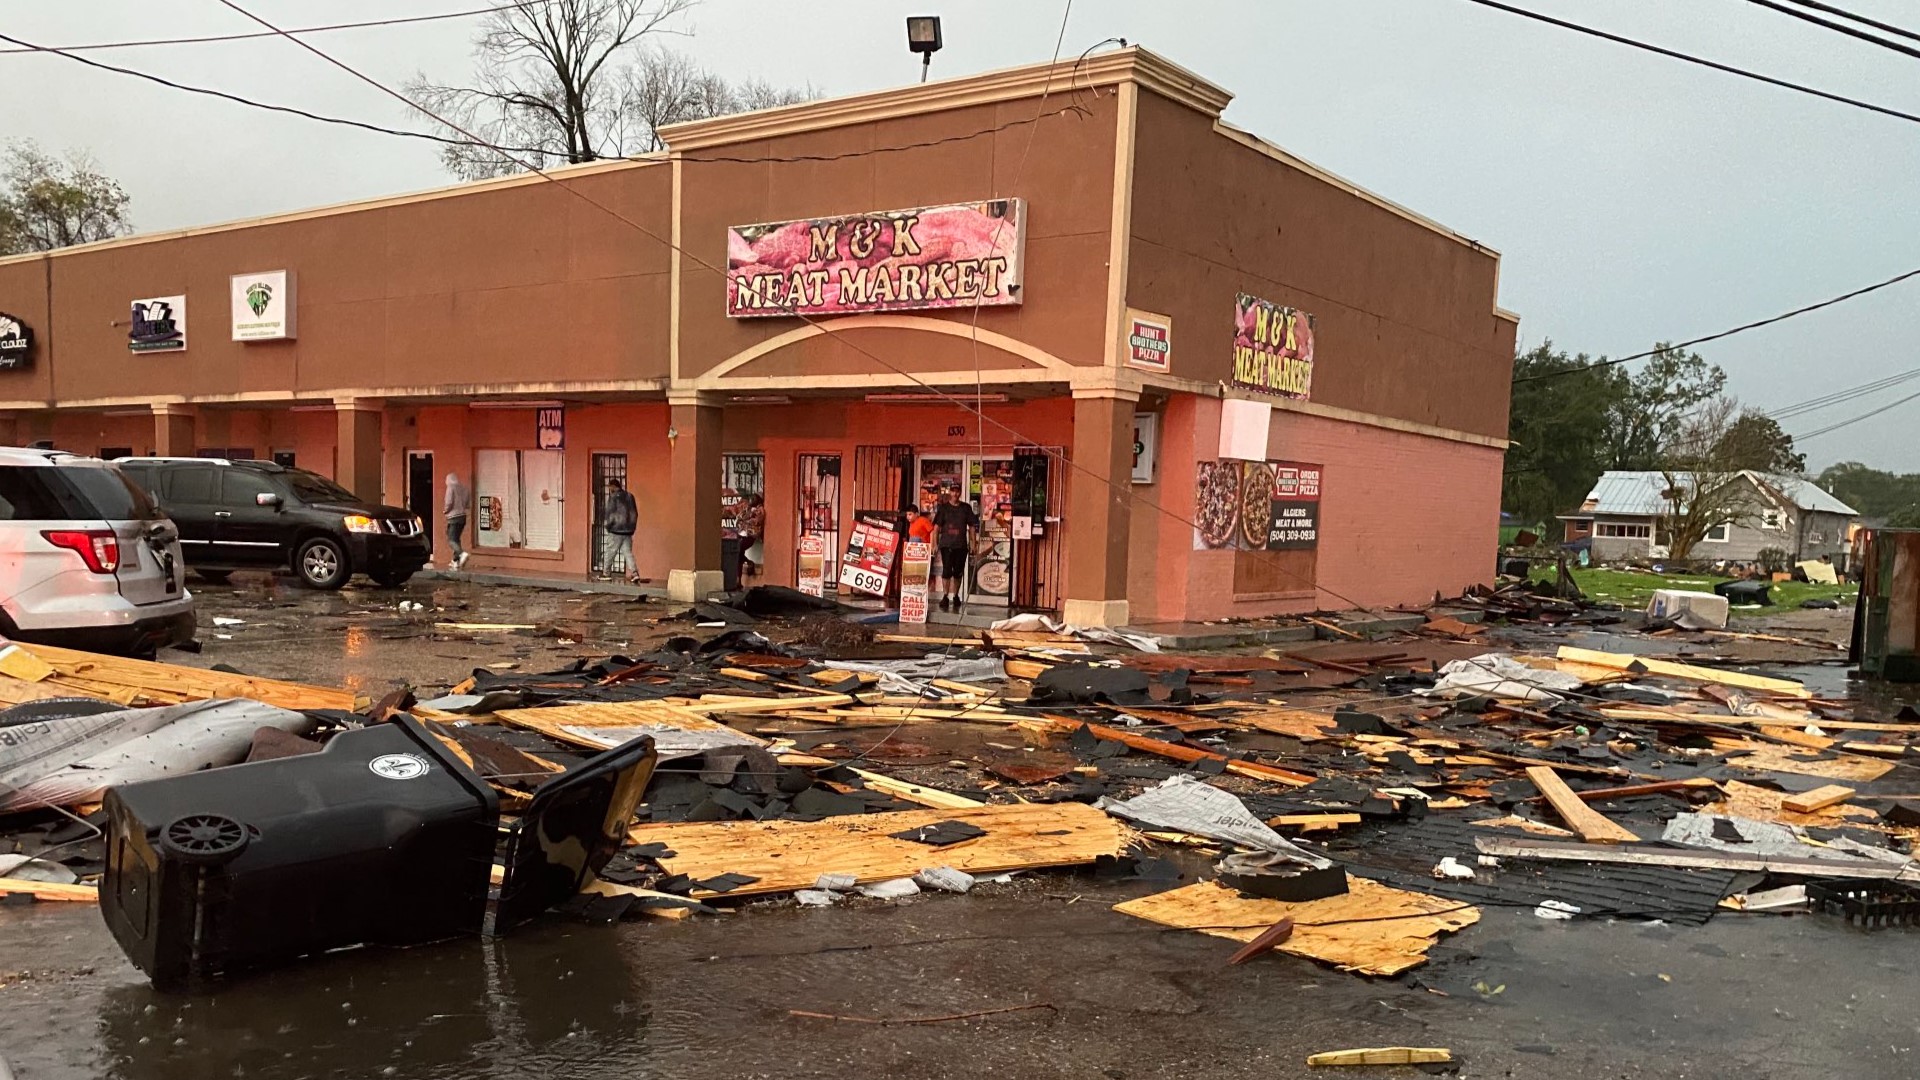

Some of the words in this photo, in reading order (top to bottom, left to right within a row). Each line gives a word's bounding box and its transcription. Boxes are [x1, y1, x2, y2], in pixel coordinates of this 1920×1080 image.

[808, 225, 844, 262] M
[850, 220, 881, 259] &
[892, 216, 922, 257] K
[734, 269, 829, 310] MEAT
[838, 256, 1007, 305] MARKET
[1139, 326, 1160, 340] HUNT
[1254, 305, 1268, 343] M
[1271, 310, 1284, 347] &
[1285, 315, 1297, 351] K
[1131, 335, 1167, 352] BROTHERS
[1138, 347, 1160, 361] PIZZA
[1234, 345, 1266, 386] MEAT
[1267, 353, 1310, 395] MARKET
[539, 410, 562, 427] ATM
[733, 461, 755, 475] KOOL
[1300, 470, 1319, 480] ORDER
[1299, 485, 1319, 496] PIZZA
[1282, 508, 1307, 517] ALGIERS
[721, 518, 738, 528] AILY
[1275, 519, 1291, 528] MEAT
[1296, 519, 1312, 528] MORE
[1270, 530, 1286, 543] (504)
[1286, 530, 1316, 541] 309-0938
[902, 596, 925, 604] CALL
[901, 609, 924, 617] SKIP
[0, 722, 51, 746] FeltB
